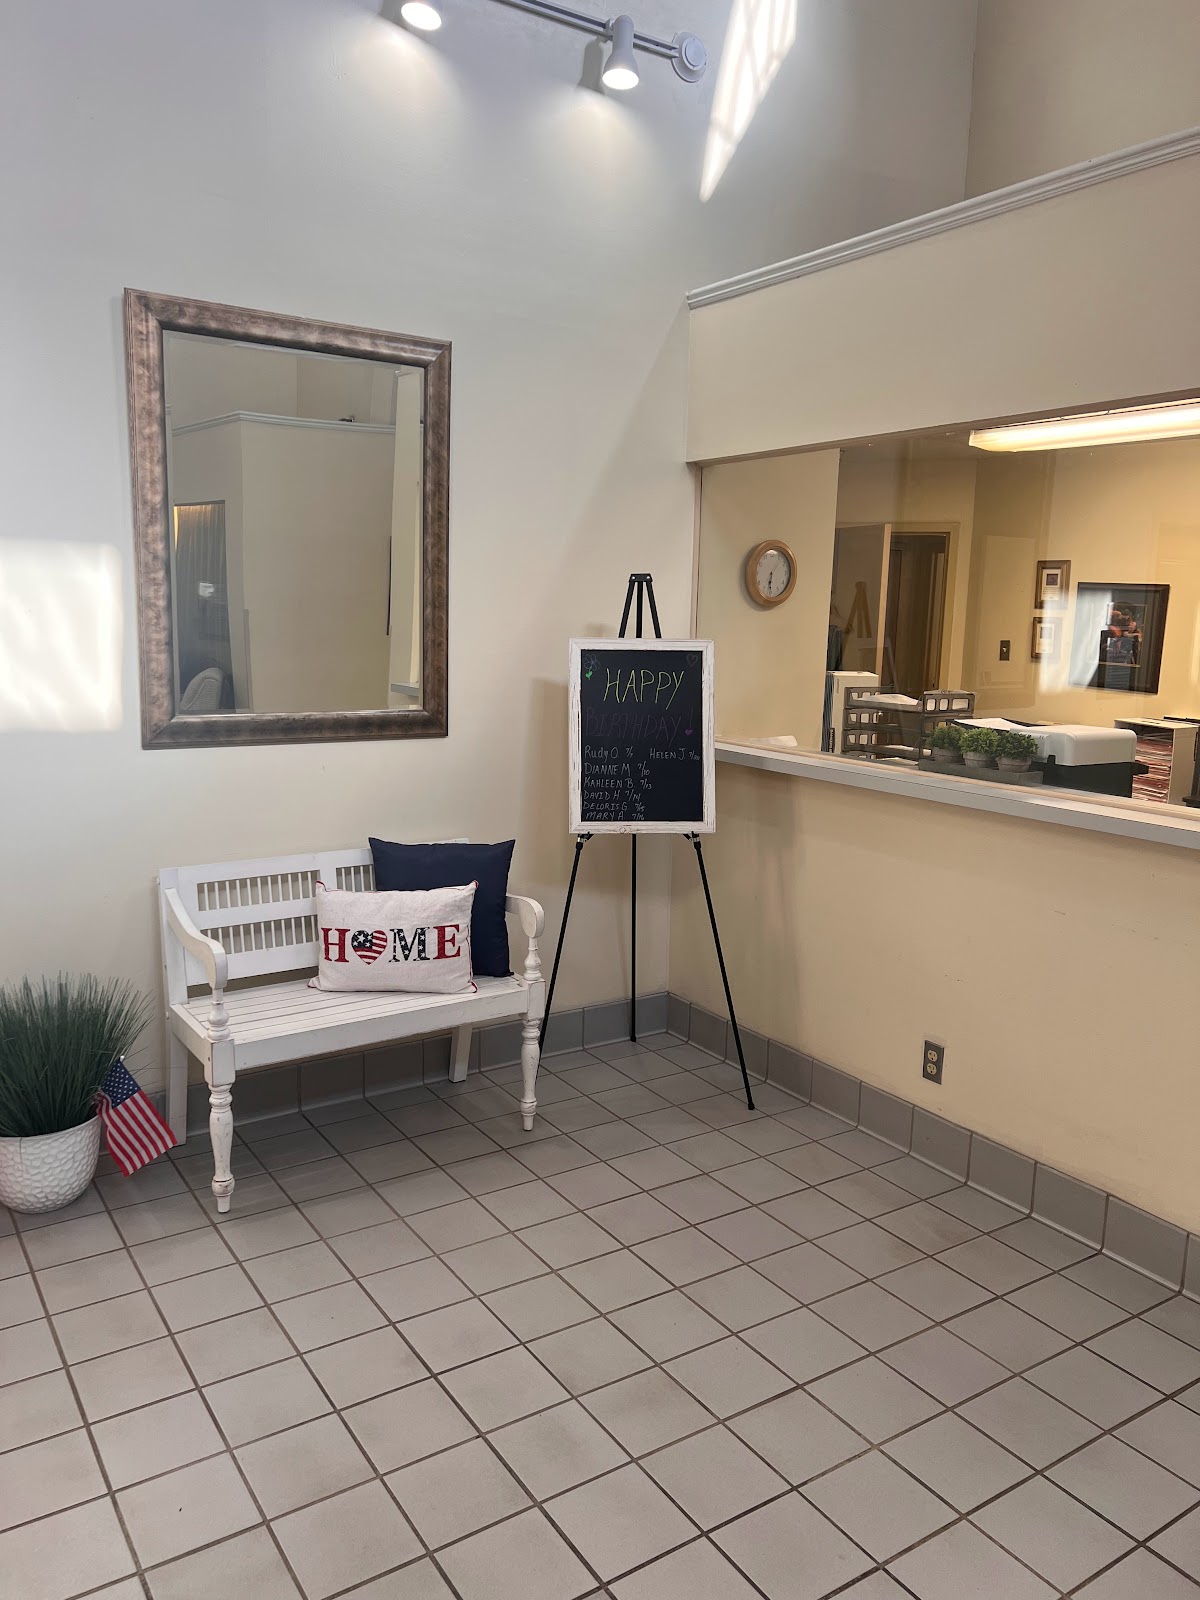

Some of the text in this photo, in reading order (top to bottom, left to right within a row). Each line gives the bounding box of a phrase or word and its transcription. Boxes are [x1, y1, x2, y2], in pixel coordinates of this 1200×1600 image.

[603, 668, 684, 710] HAPPY
[584, 744, 608, 763] Rudy
[649, 747, 676, 760] HELEN
[637, 760, 650, 777] 7/10
[639, 777, 652, 790] 7/13
[583, 789, 611, 800] DAVID
[583, 801, 620, 811] DELORIS
[585, 811, 615, 821] MARY
